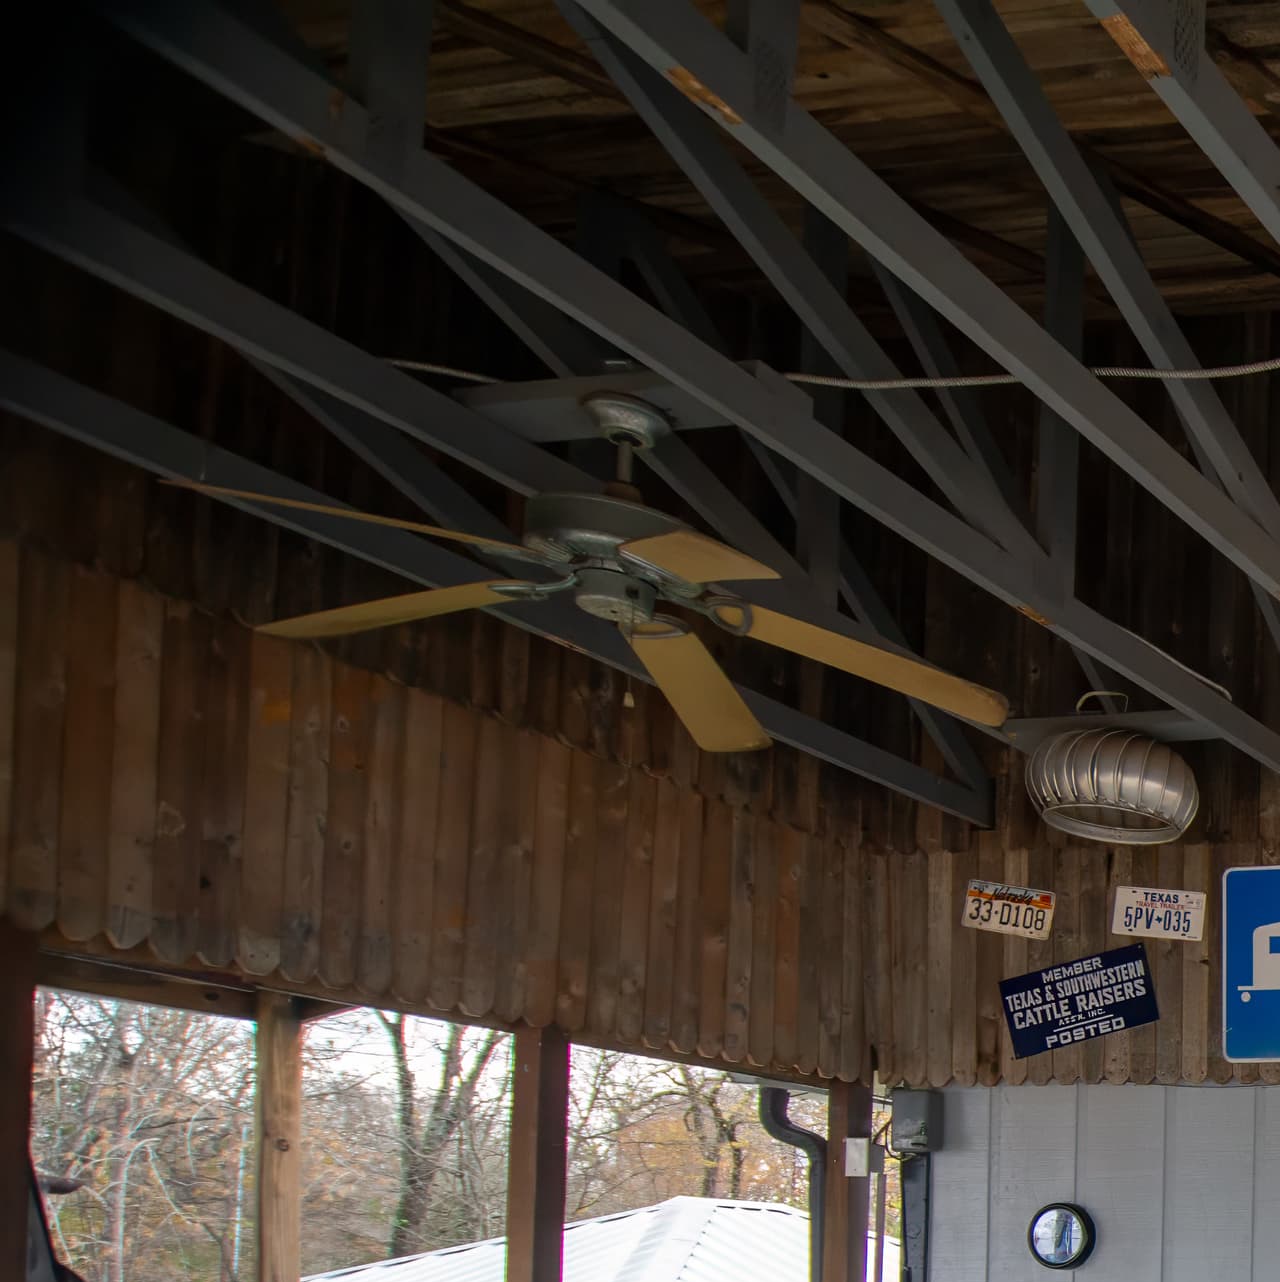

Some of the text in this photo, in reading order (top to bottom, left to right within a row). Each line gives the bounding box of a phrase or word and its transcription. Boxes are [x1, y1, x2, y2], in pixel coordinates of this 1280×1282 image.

[1136, 900, 1159, 909] TRAVEL
[1143, 892, 1179, 904] TEXAS
[1041, 956, 1103, 984] MEMBER
[1005, 959, 1145, 1012] TEXAS & SOUTHWESTERN
[1012, 978, 1147, 1030] CATTLE RAISERS
[1045, 1016, 1126, 1049] POSTED
